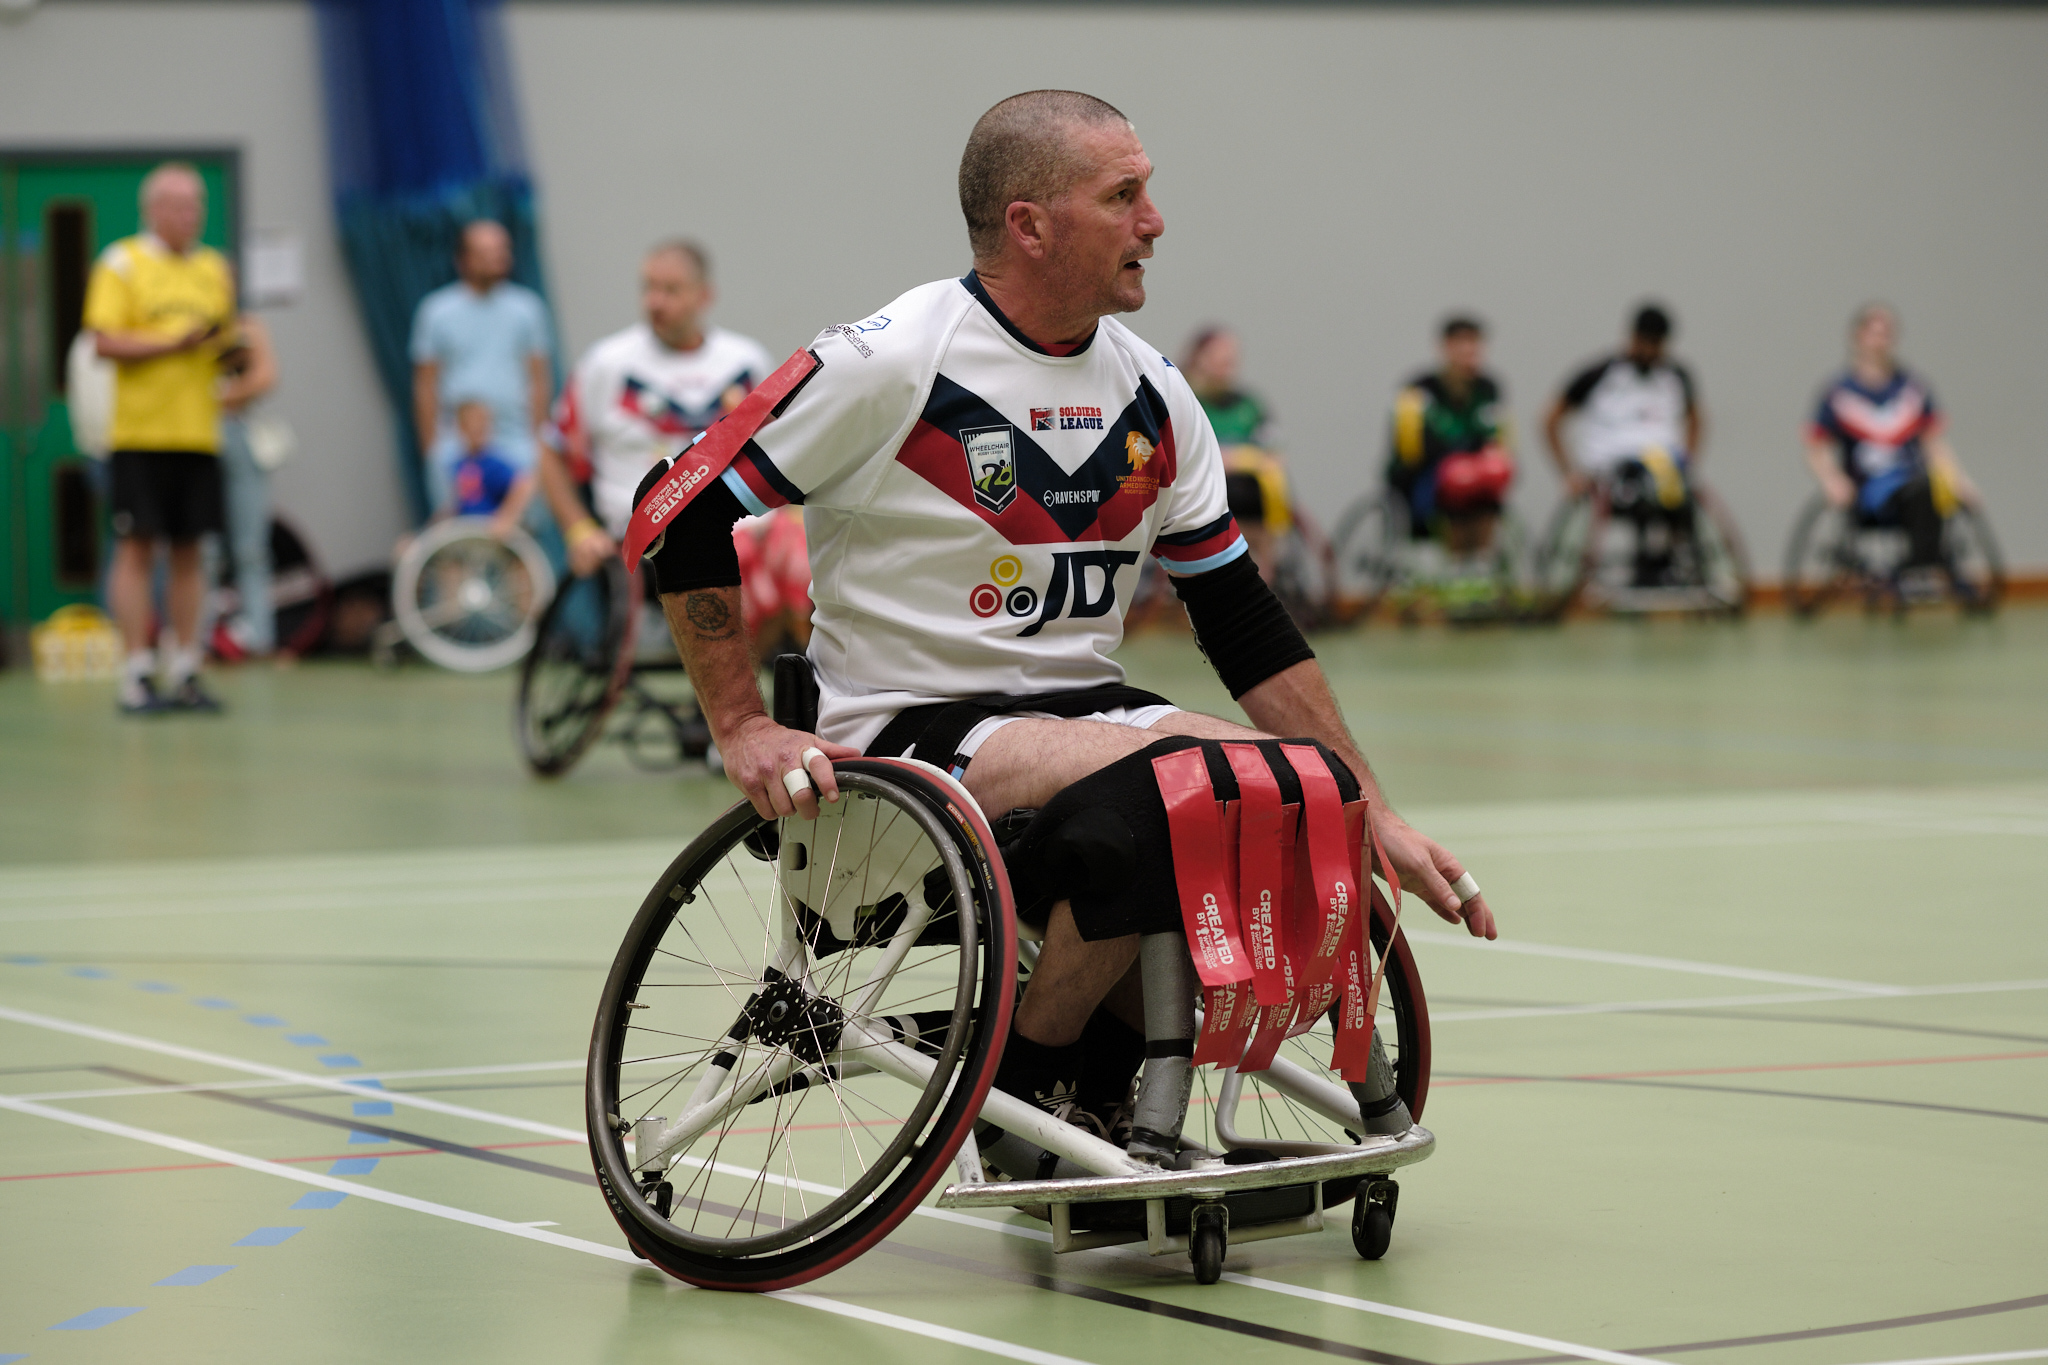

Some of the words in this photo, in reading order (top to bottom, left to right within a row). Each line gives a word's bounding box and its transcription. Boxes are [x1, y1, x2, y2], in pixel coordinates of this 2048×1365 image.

[1059, 406, 1102, 417] SOLDIERS
[1060, 417, 1104, 430] LEAGUE
[969, 442, 1010, 452] WHEELCHAIR
[650, 464, 709, 523] CREATED
[679, 469, 690, 483] BY
[1016, 549, 1141, 637] JDT
[1196, 912, 1207, 926] BY
[1252, 908, 1260, 921] BY
[1326, 881, 1348, 957] CREATED
[1330, 898, 1337, 912] BY
[1202, 892, 1234, 965] CREATED
[1261, 889, 1275, 969] CREATED
[1220, 983, 1236, 1031] EATED
[1350, 950, 1363, 1029] CREATED
[598, 1168, 623, 1213] KENDA
